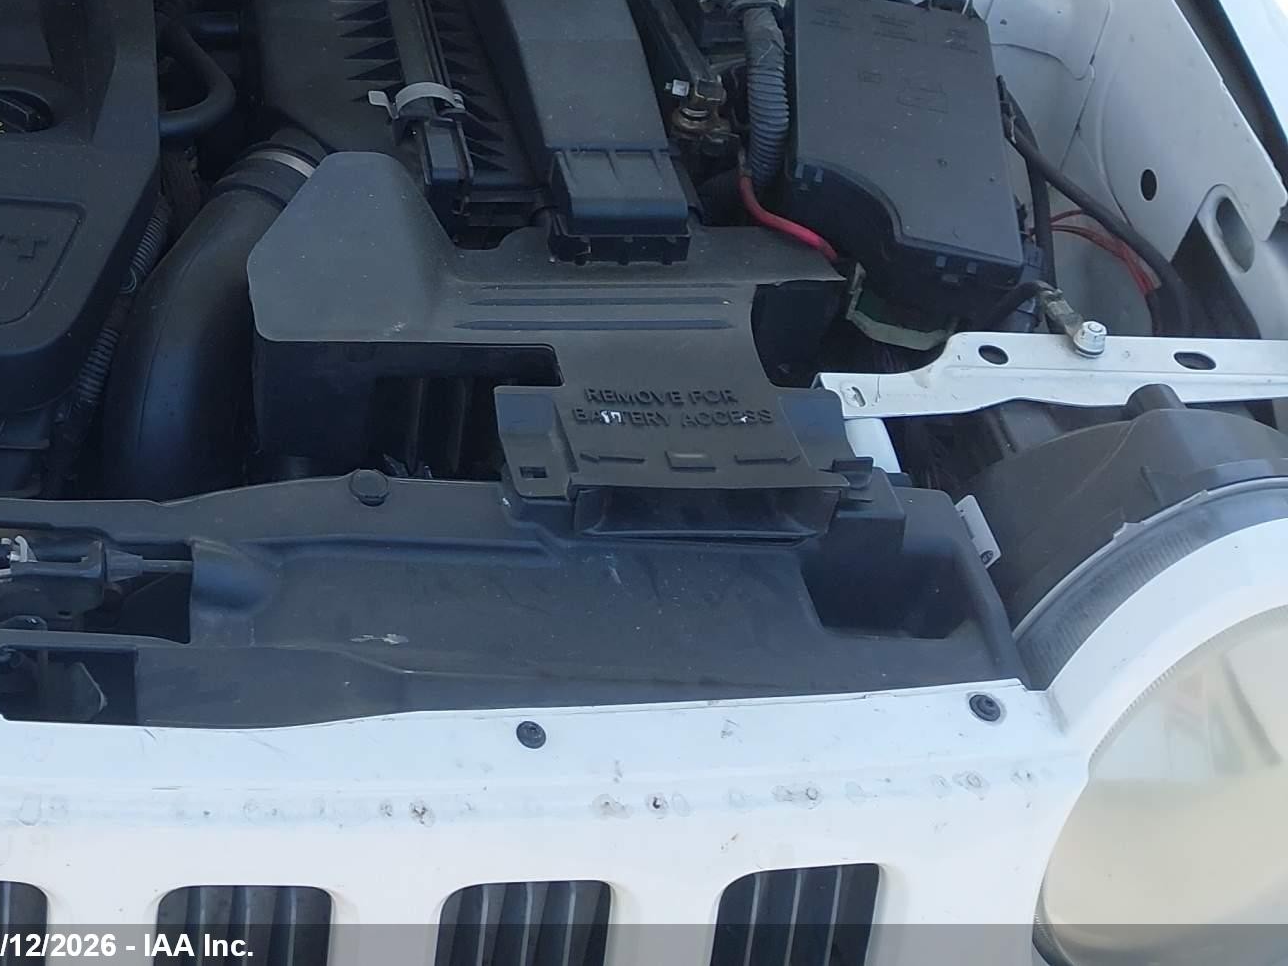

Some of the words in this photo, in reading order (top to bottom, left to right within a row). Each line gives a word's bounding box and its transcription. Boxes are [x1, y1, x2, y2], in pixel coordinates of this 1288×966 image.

[584, 387, 684, 406] REMOVE
[688, 389, 739, 405] FOR
[681, 409, 775, 427] ACCESS
